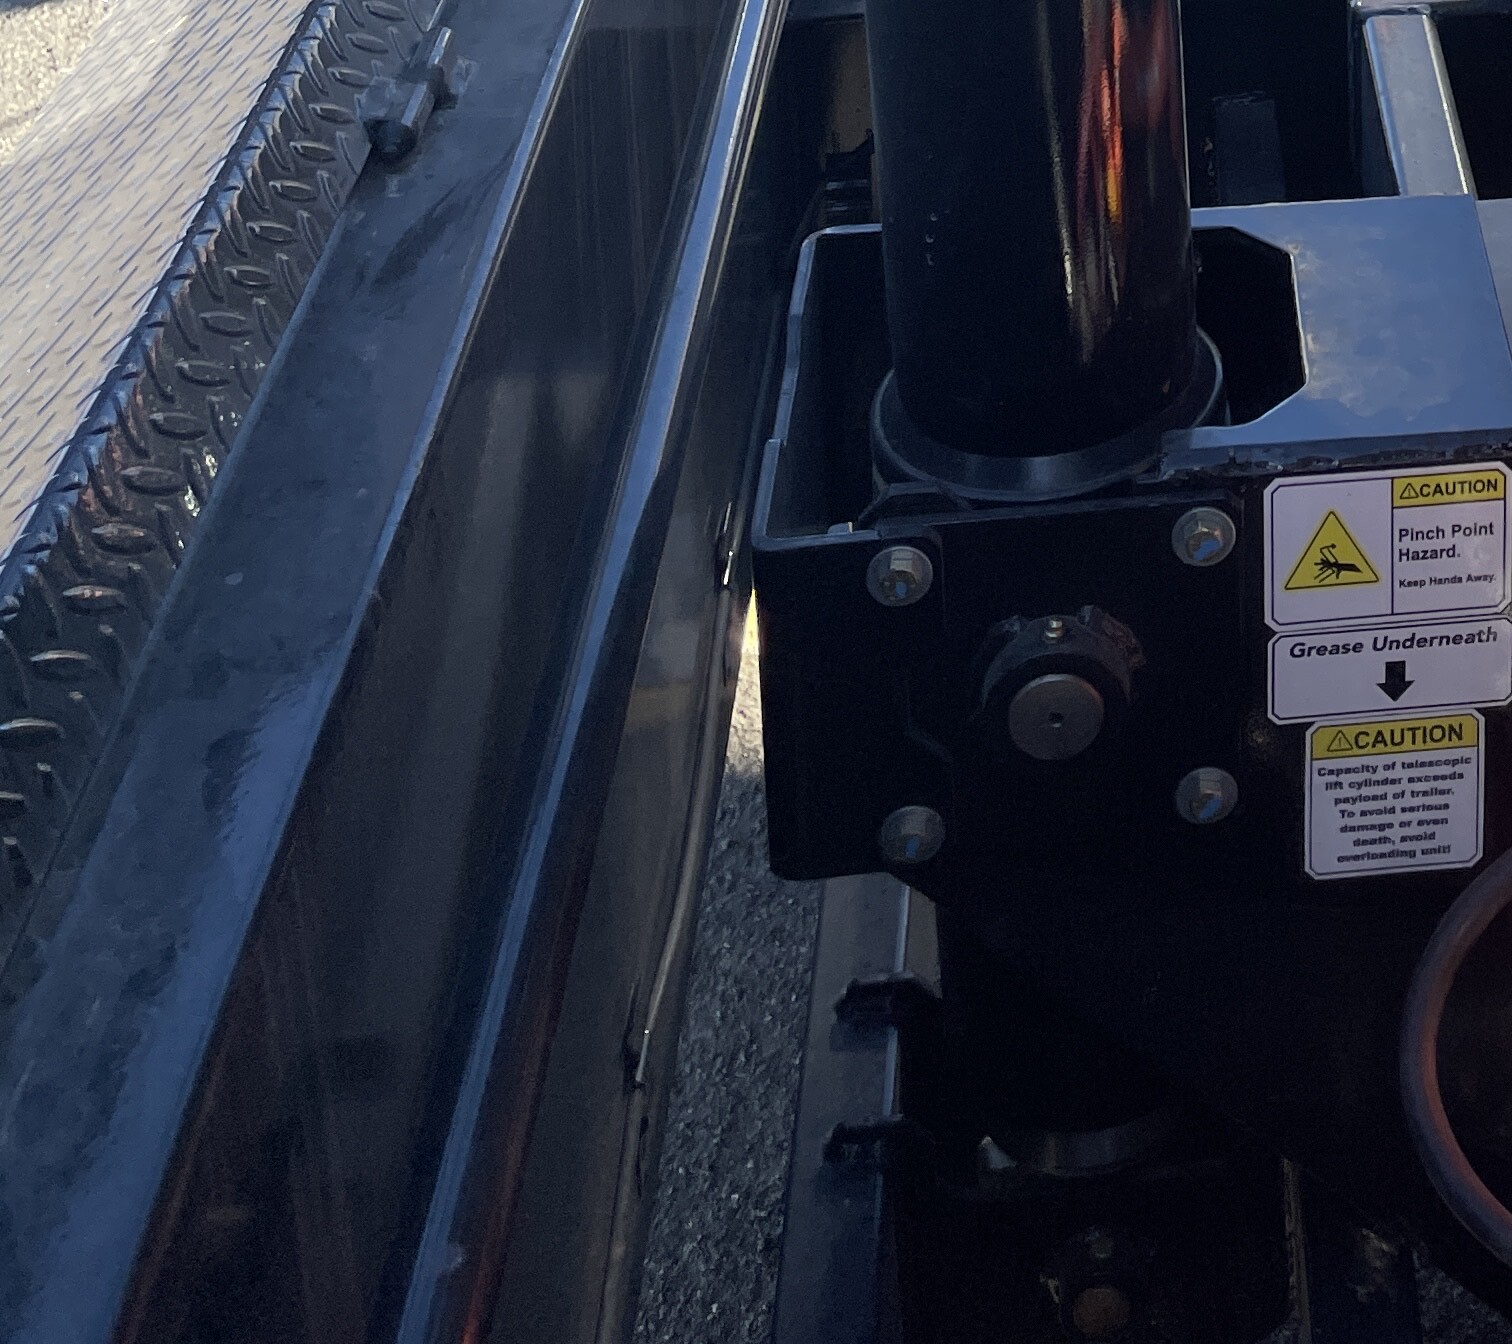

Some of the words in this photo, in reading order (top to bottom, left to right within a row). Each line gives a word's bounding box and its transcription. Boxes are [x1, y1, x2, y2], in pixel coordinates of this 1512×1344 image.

[1420, 478, 1498, 498] CAUTION
[1398, 525, 1445, 542] Pinch
[1452, 522, 1494, 538] Point
[1398, 544, 1461, 562] Hazard.
[1399, 578, 1427, 589] Keep
[1429, 575, 1462, 586] Hands
[1289, 639, 1365, 660] Grease
[1372, 626, 1498, 652] Underneath
[1354, 723, 1463, 749] CAUTION
[1317, 763, 1378, 778] Capacity
[1383, 762, 1397, 772] of
[1401, 756, 1472, 770] telescopic
[1325, 779, 1343, 791] lift
[1348, 777, 1403, 791] cylinder
[1408, 771, 1464, 784] exceeds
[1334, 792, 1388, 807] payload
[1392, 790, 1405, 800] of
[1339, 810, 1355, 819] To
[1360, 806, 1396, 818] avoid
[1400, 801, 1450, 814] serious
[1339, 821, 1394, 834] damage
[1399, 820, 1412, 829] or
[1417, 817, 1449, 827] even
[1353, 835, 1395, 847] death,
[1400, 831, 1436, 843] avoid
[1337, 848, 1416, 863] overloading
